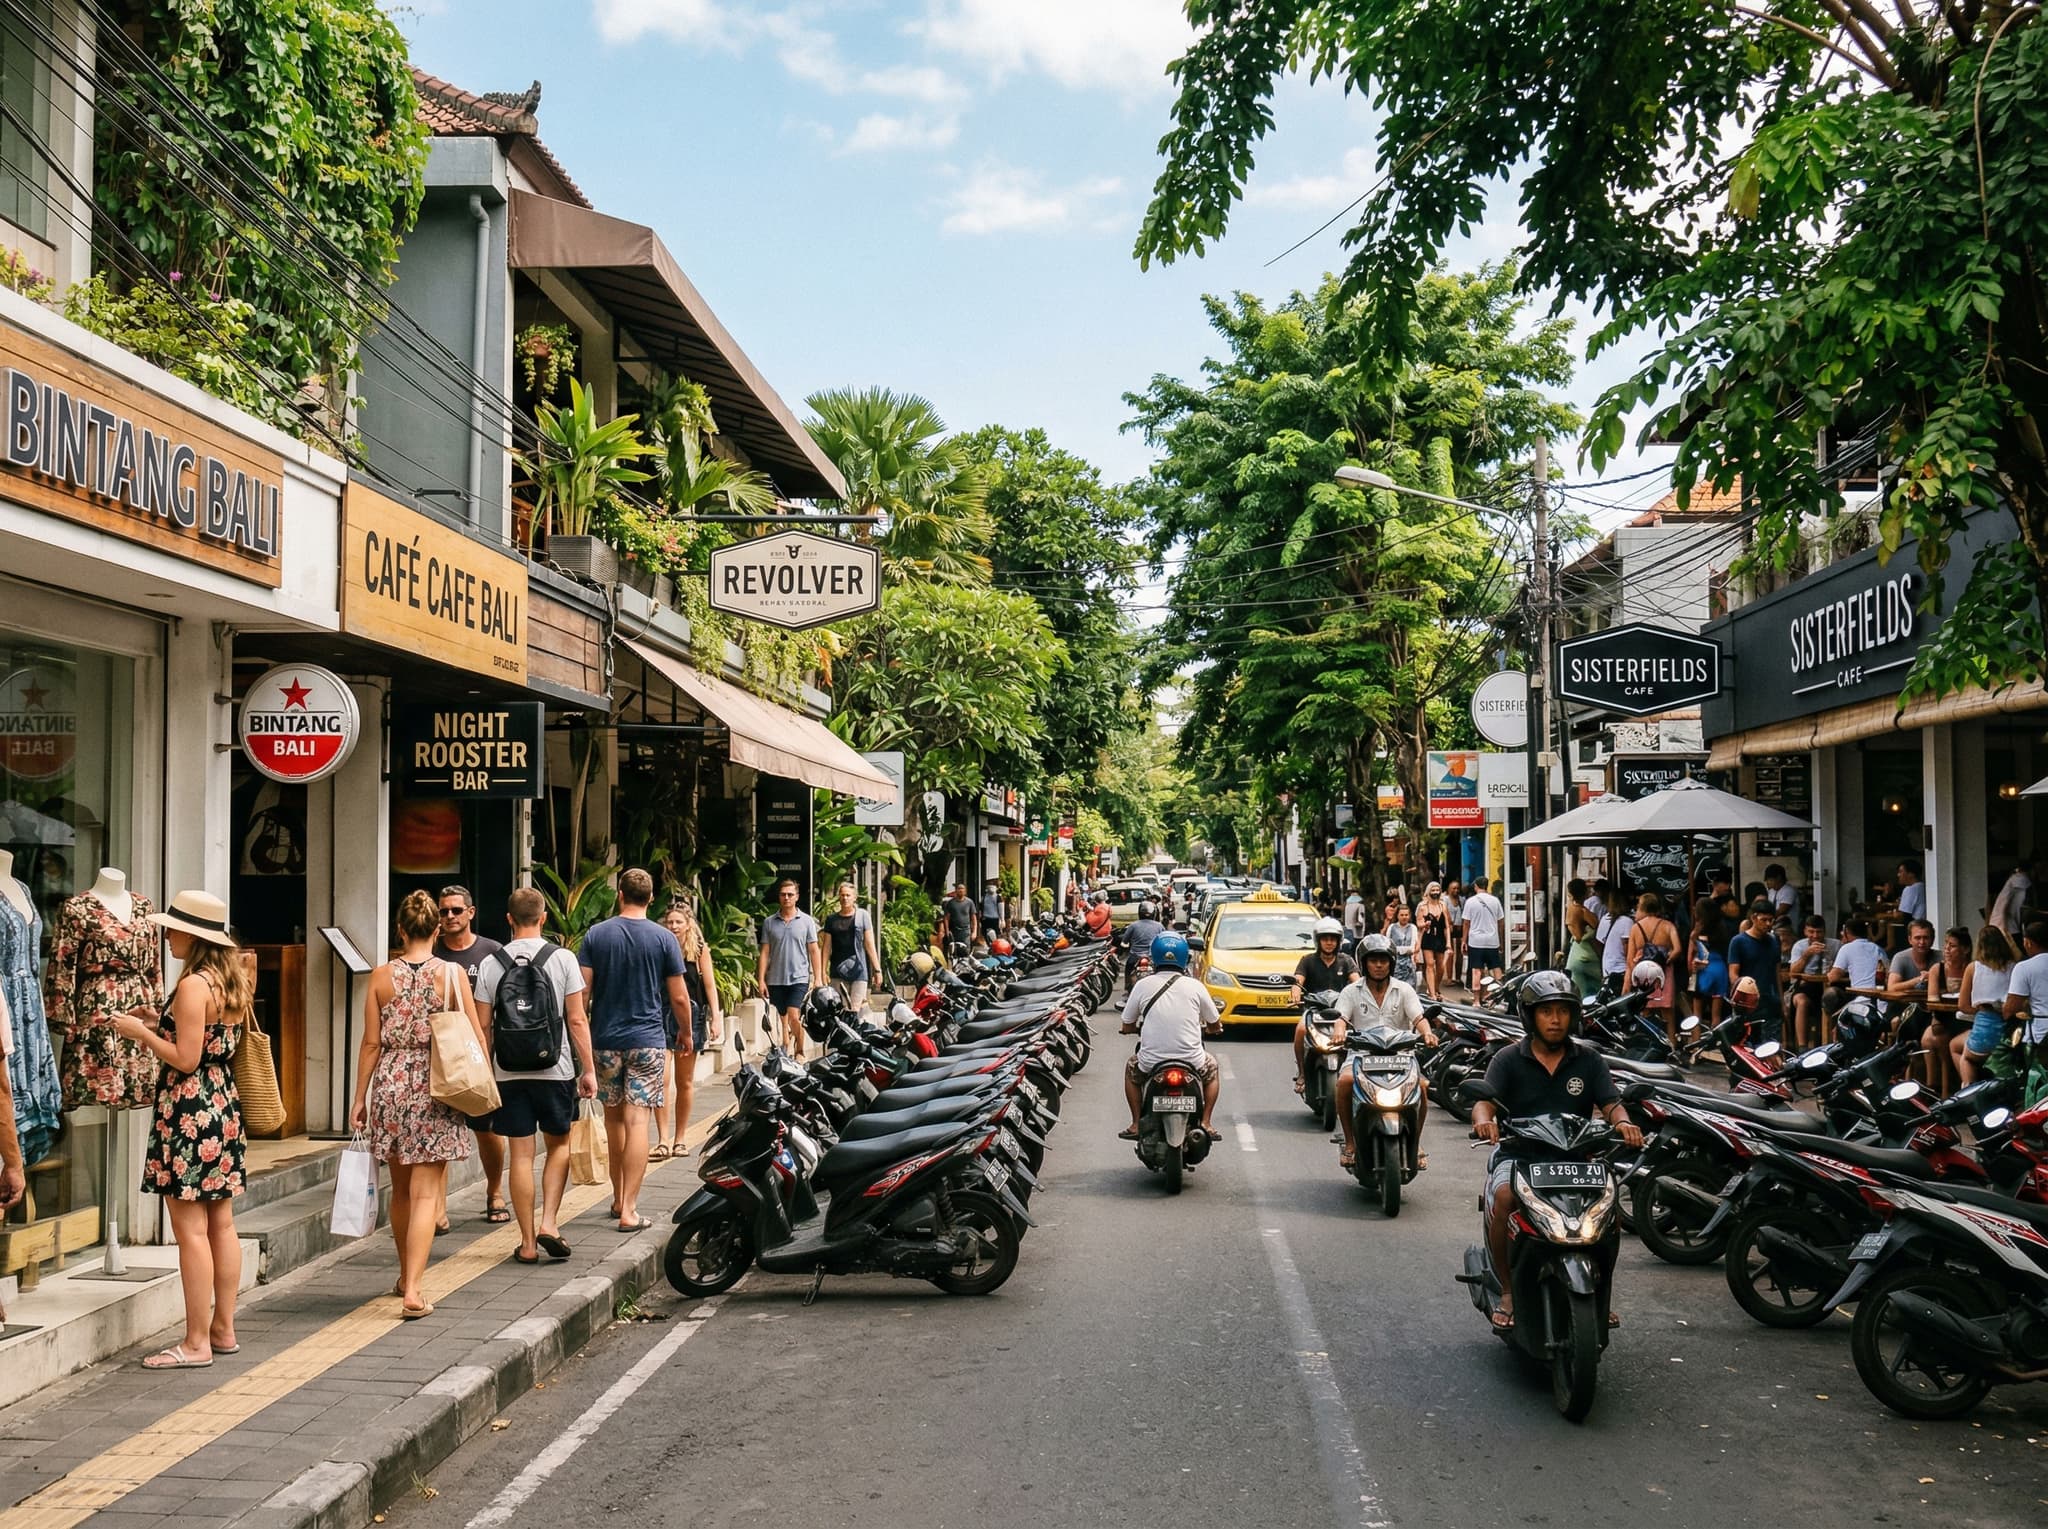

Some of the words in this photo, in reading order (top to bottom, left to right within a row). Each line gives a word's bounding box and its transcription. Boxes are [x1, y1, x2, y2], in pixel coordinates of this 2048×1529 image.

[7, 367, 196, 528] BINTANG
[204, 455, 280, 558] BALI
[364, 530, 421, 610] CAFÉ
[427, 557, 476, 630] CAFE
[481, 580, 518, 646] BALI
[724, 565, 864, 595] REVOLVER
[1790, 572, 1913, 674] SISTERFIELDS
[1571, 658, 1708, 683] SISTERFIELDS
[1837, 666, 1862, 688] CAFE
[1624, 686, 1654, 696] CAFE
[249, 714, 341, 734] BINTANG
[434, 711, 509, 739] NIGHT
[273, 740, 316, 757] BALI
[415, 741, 528, 768] ROOSTER
[452, 770, 489, 791] BAR
